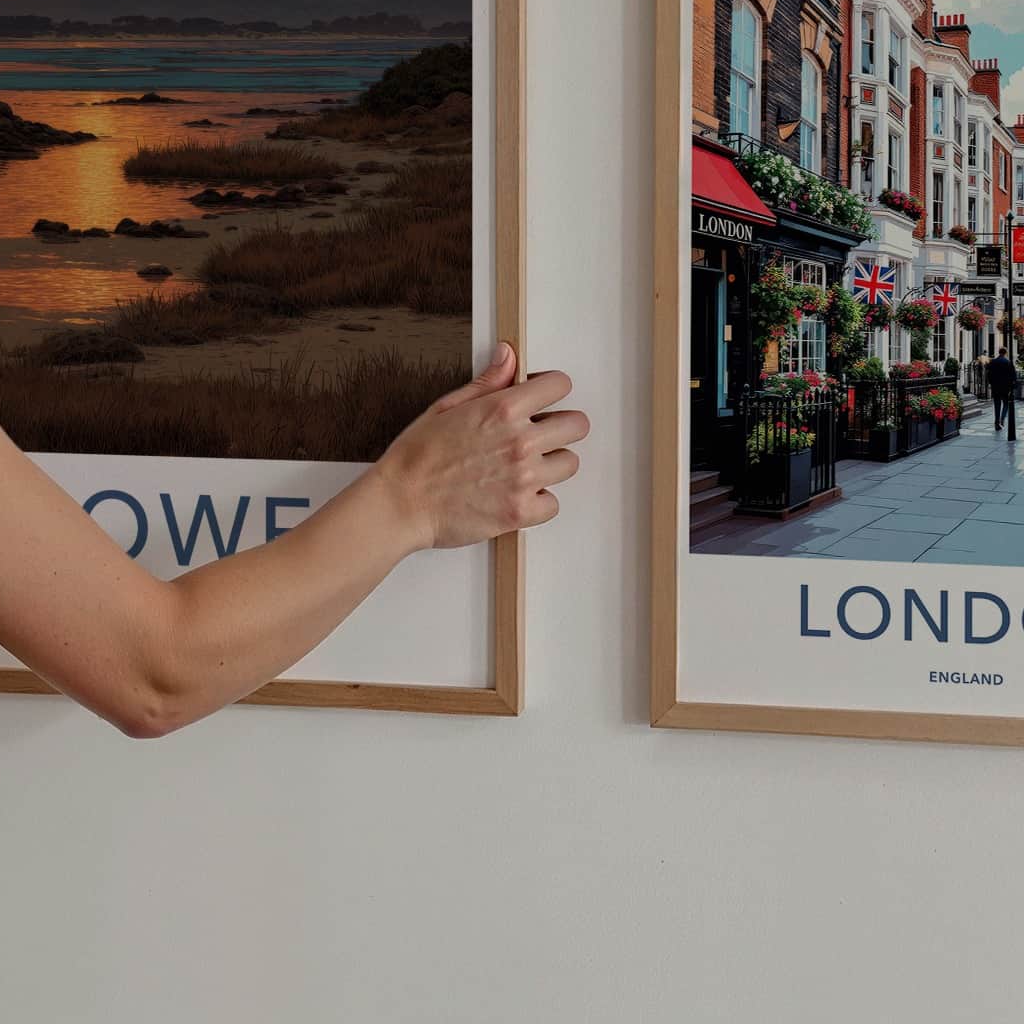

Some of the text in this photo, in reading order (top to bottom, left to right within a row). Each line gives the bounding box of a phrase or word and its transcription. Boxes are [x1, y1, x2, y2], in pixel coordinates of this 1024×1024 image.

[698, 213, 753, 242] LONDON
[800, 584, 1024, 644] LOND
[929, 671, 1004, 686] ENGLAND
